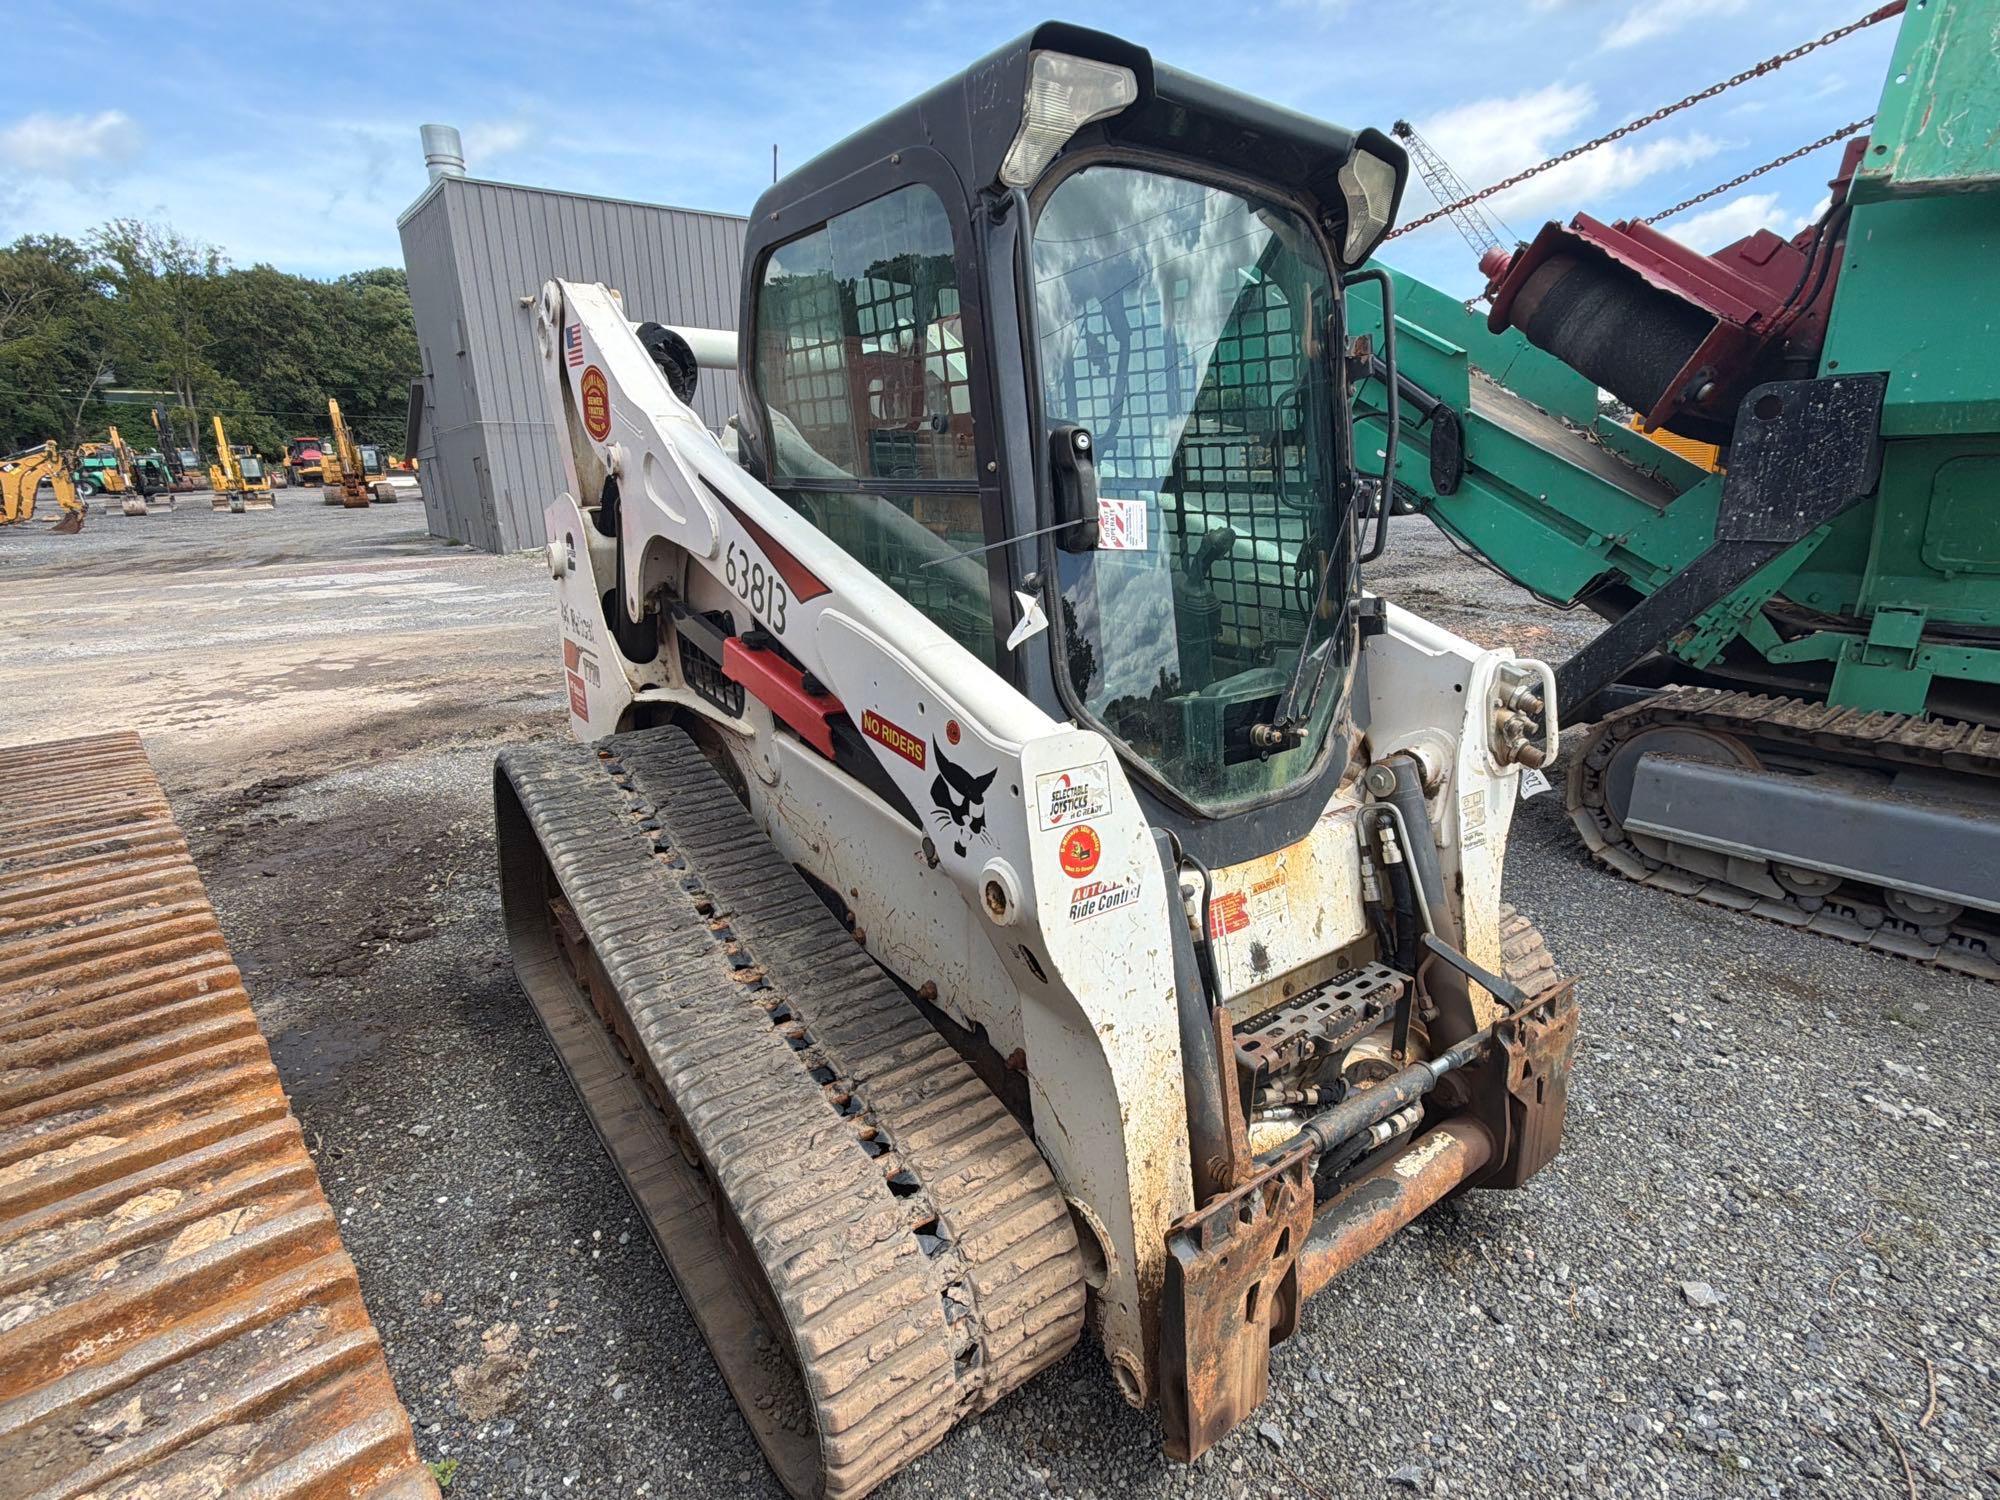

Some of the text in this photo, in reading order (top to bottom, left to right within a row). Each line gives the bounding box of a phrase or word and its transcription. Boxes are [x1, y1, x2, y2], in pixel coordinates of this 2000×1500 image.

[726, 541, 787, 635] 63813
[864, 714, 880, 735] NO
[882, 724, 923, 761] RIDERS
[1051, 784, 1089, 802] SELECTABLE
[1050, 795, 1088, 816] JOYSTICKS
[1069, 901, 1096, 920] Ride
